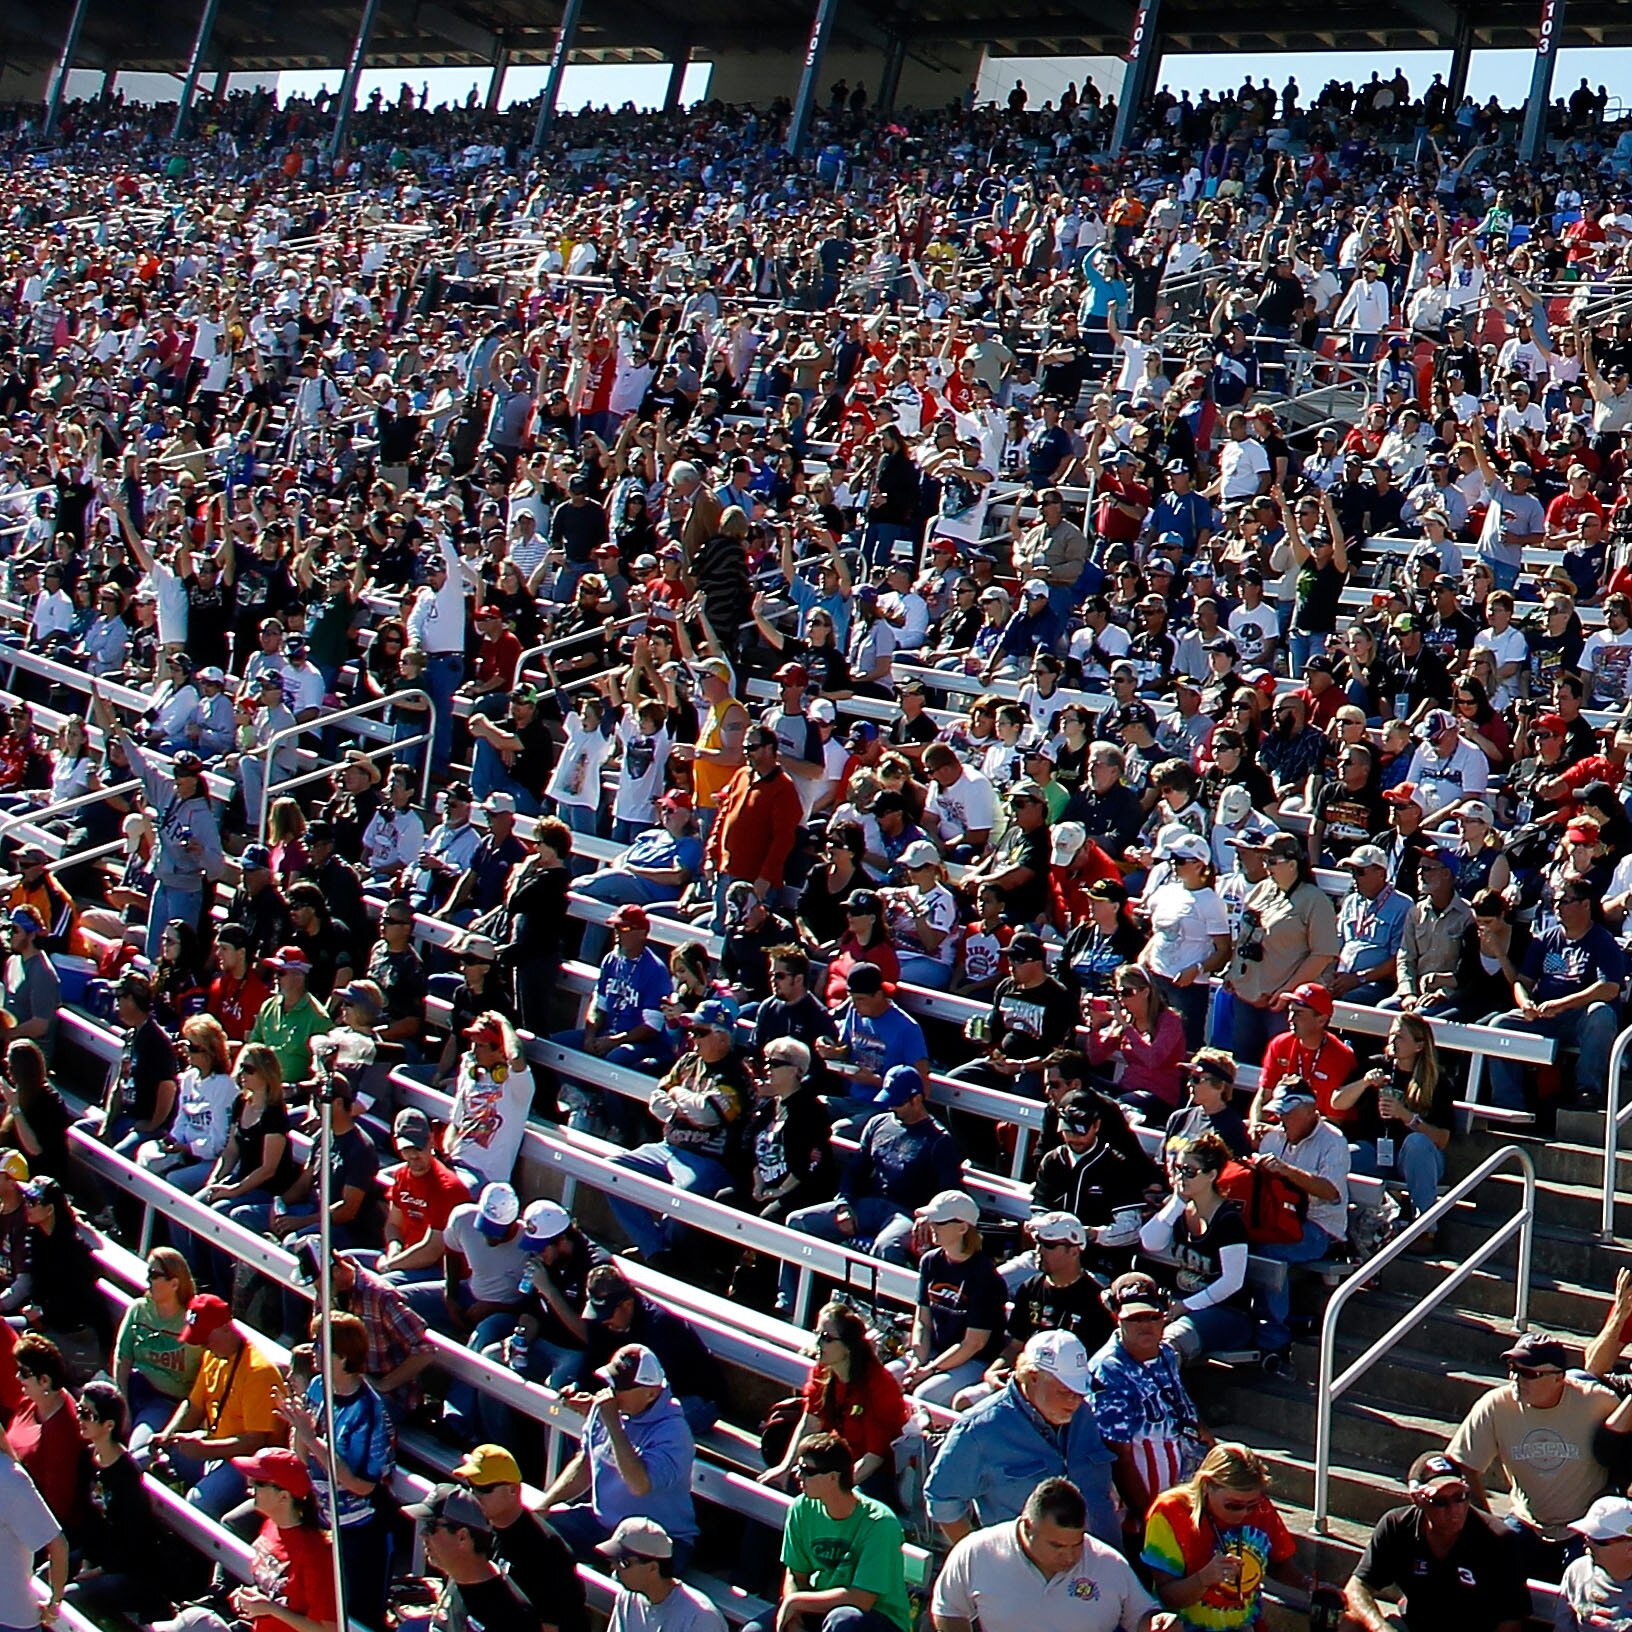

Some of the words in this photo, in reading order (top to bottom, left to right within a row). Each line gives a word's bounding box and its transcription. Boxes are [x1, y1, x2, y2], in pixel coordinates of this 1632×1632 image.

[551, 29, 567, 68] 106
[806, 23, 822, 66] 105
[1130, 11, 1147, 58] 104
[1538, 2, 1555, 54] 103
[1511, 1441, 1581, 1461] NASCAR
[1458, 1567, 1477, 1586] 3
